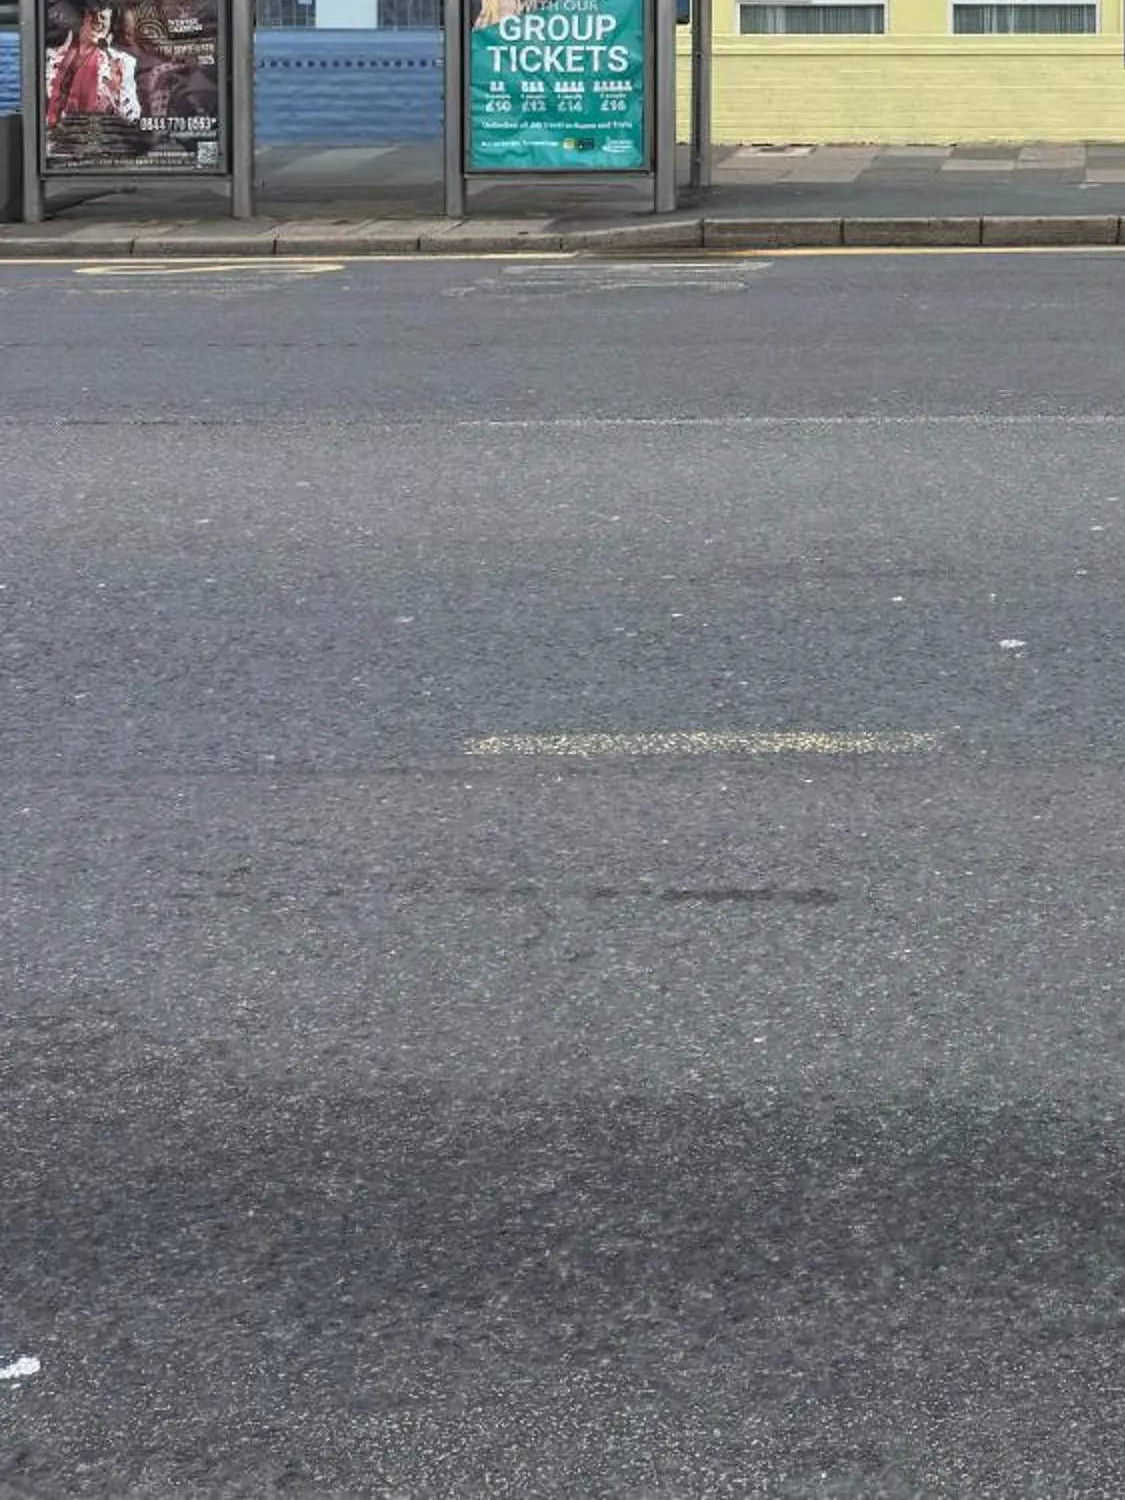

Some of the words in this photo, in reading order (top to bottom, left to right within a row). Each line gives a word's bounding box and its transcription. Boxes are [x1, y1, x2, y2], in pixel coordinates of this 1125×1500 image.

[516, 0, 559, 12] WITH
[564, 0, 598, 11] OUR
[499, 14, 617, 41] GROUP
[487, 45, 629, 73] TICKETS
